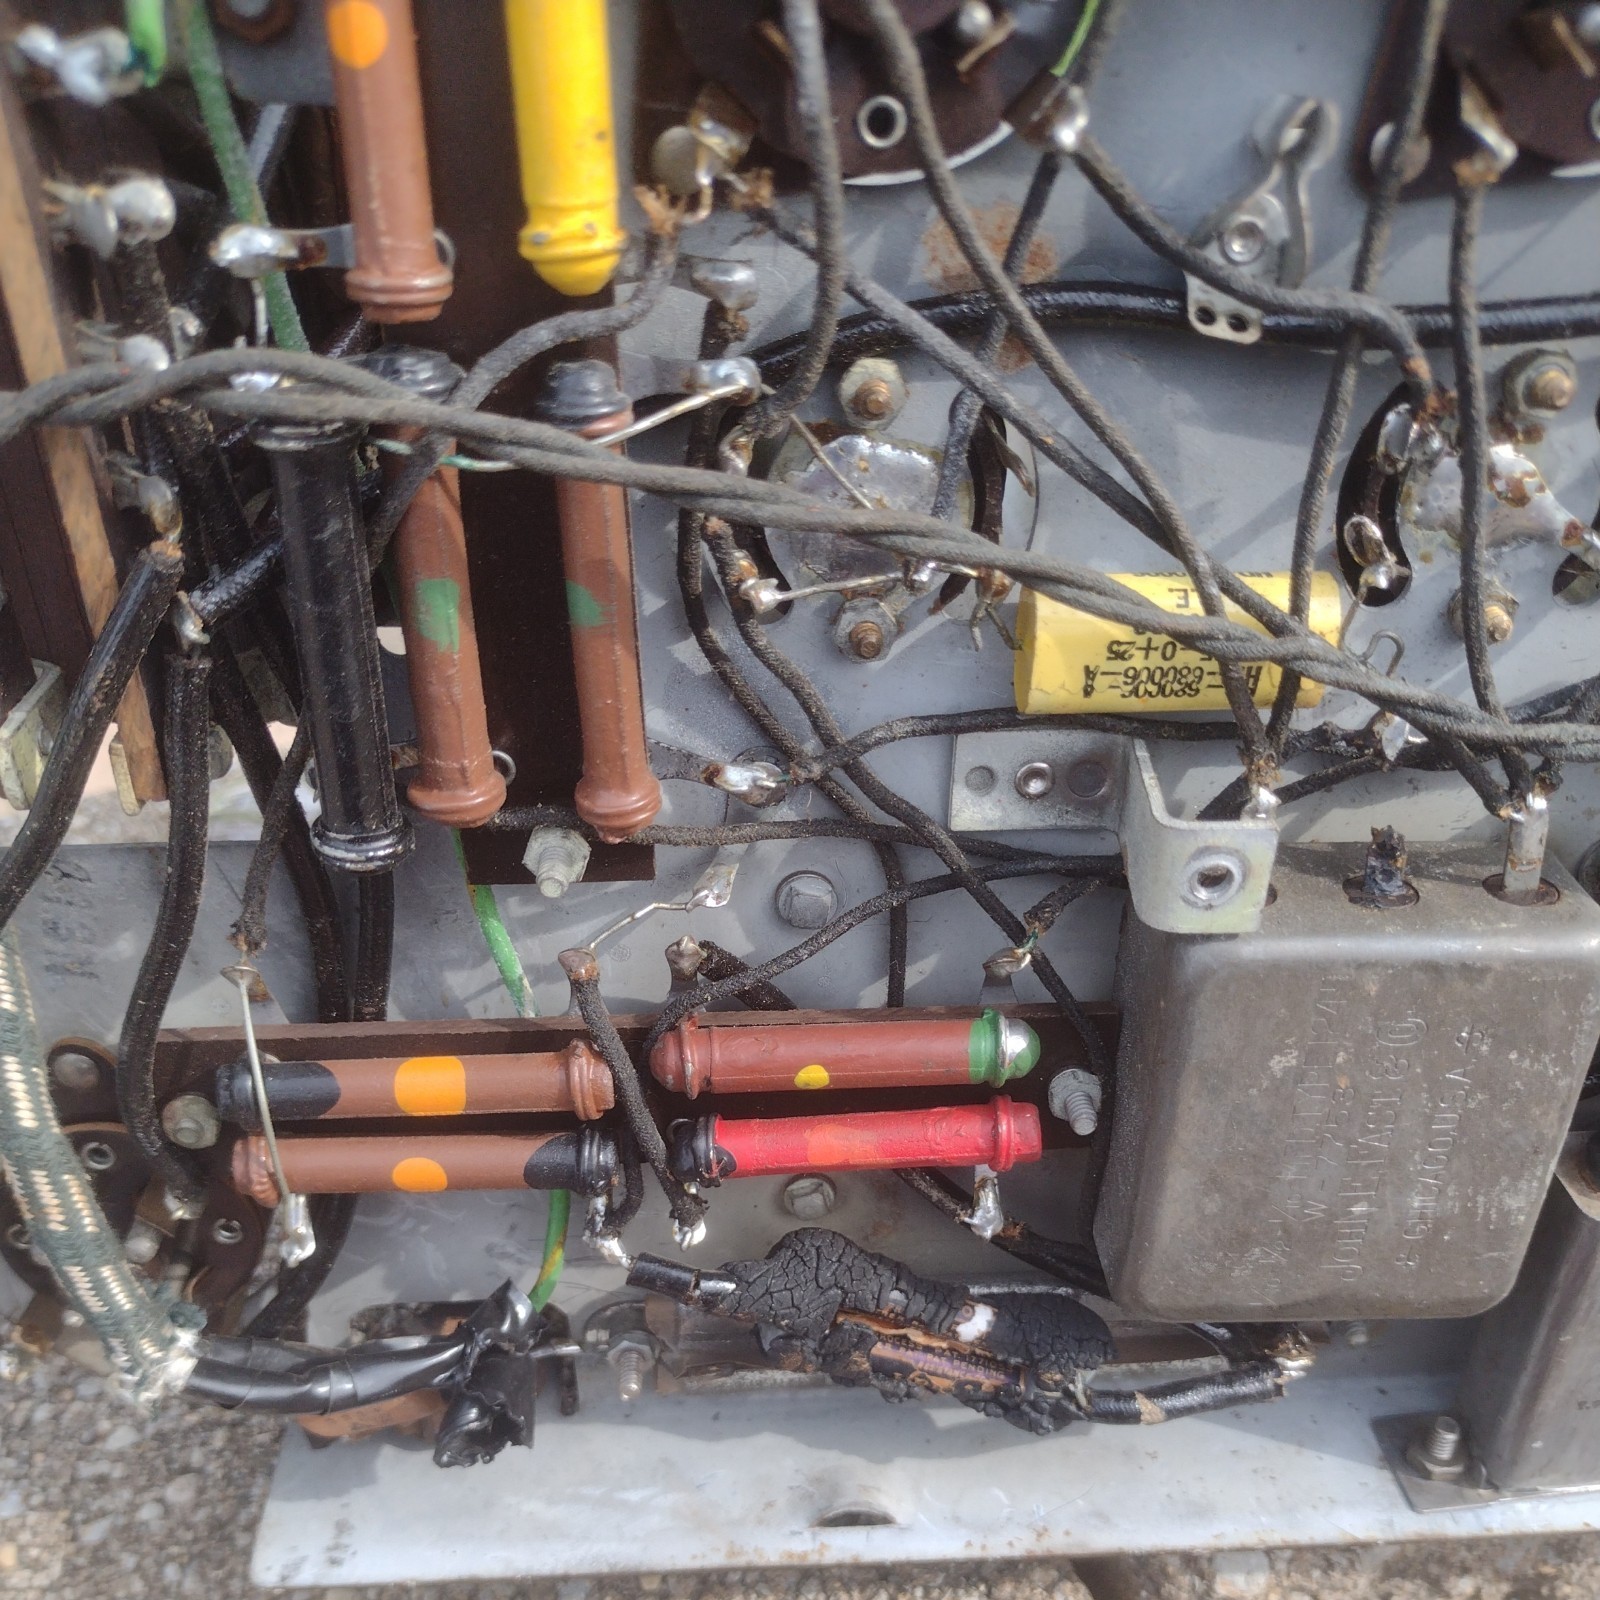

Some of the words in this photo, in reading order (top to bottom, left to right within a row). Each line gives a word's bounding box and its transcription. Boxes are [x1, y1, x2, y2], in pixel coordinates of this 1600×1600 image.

[1346, 1088, 1402, 1164] FAST
[1319, 1204, 1378, 1281] JOHN
[951, 1359, 1006, 1379] PENDING
